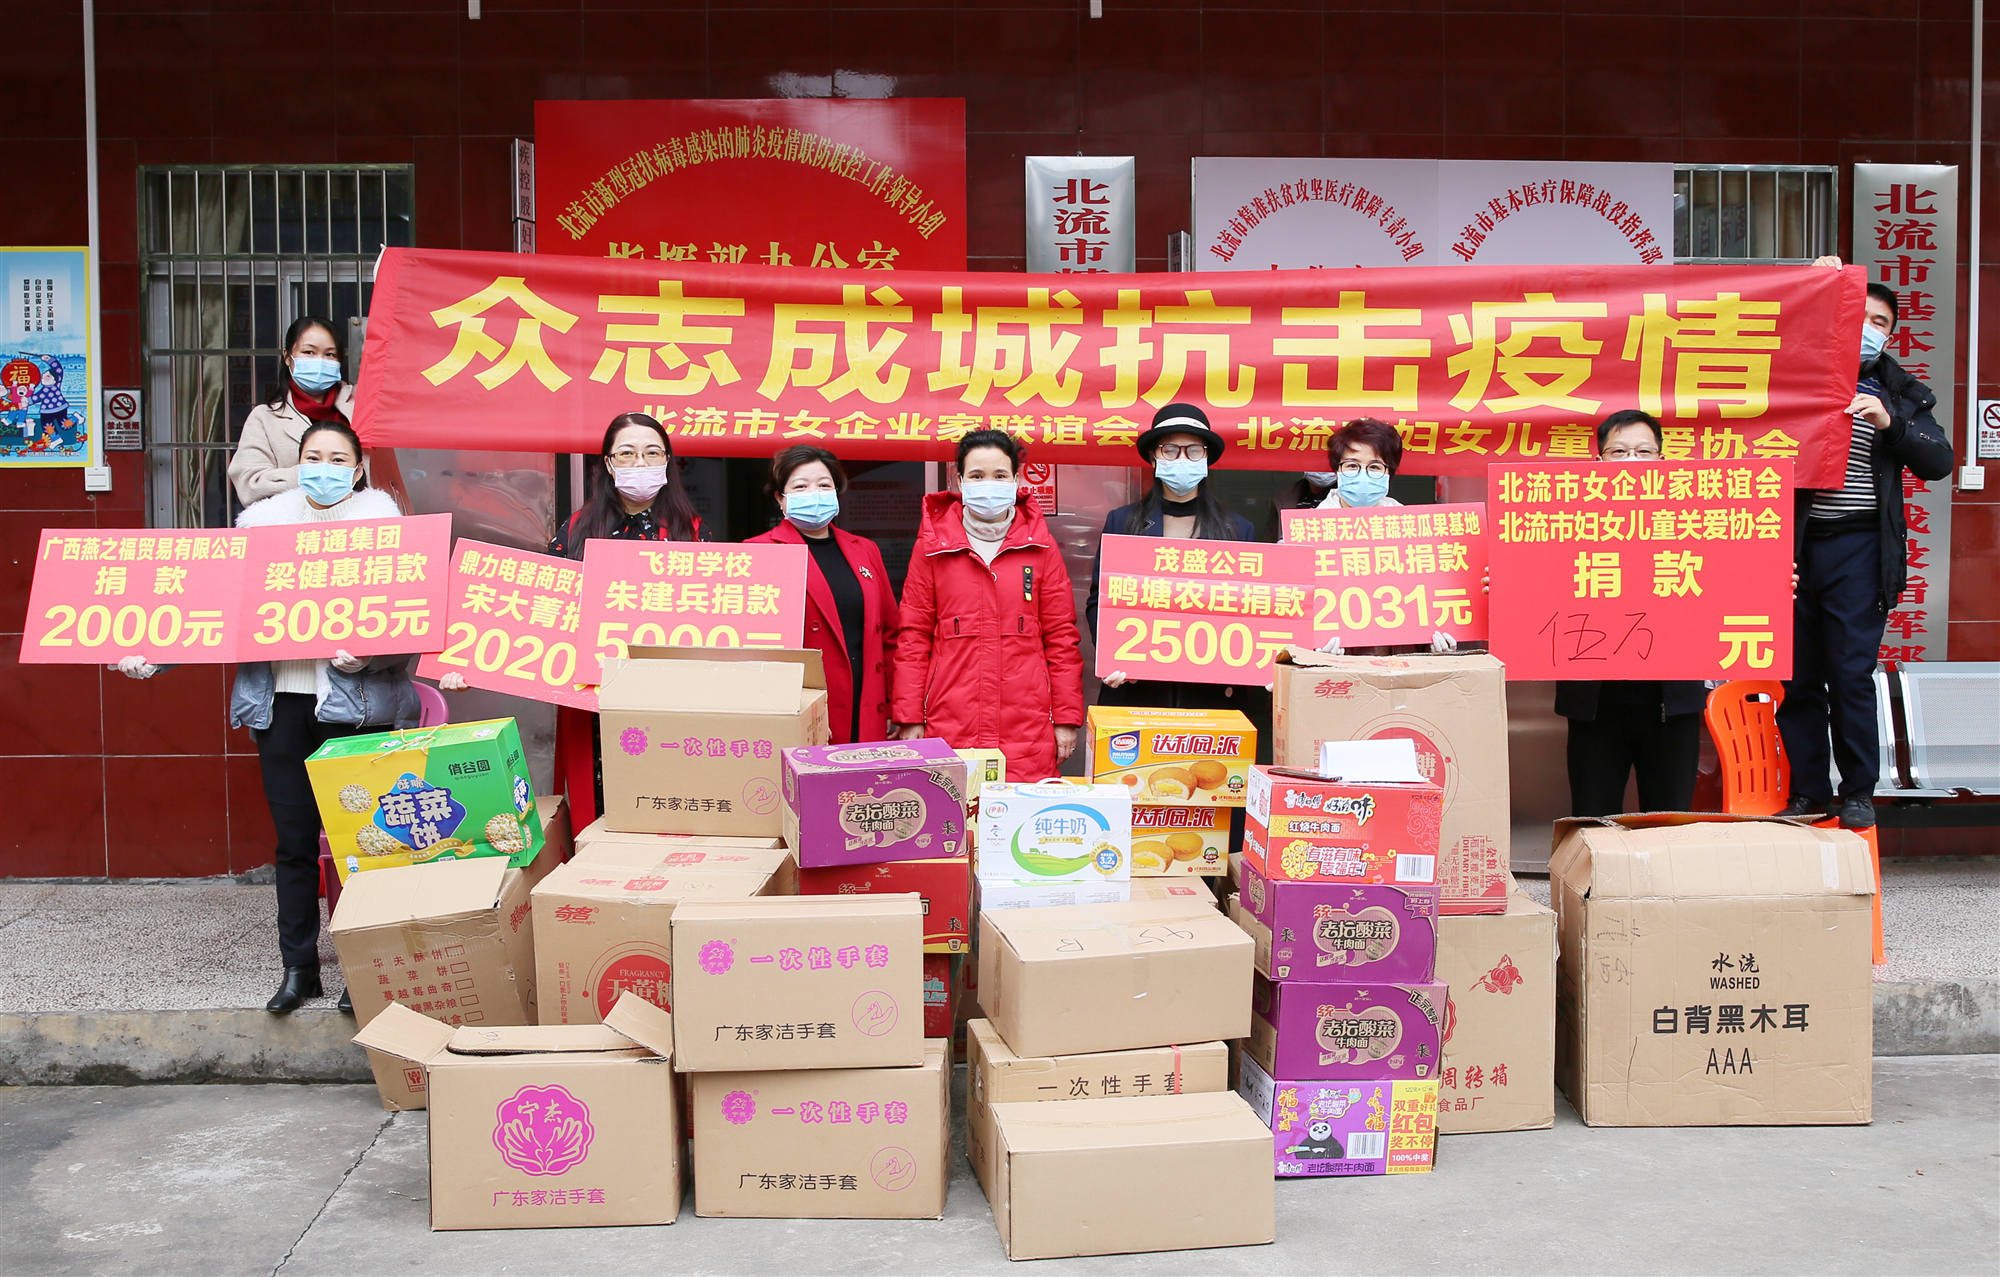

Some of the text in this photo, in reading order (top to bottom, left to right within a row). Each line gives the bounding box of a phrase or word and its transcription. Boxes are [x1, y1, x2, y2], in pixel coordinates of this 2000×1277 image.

[556, 125, 947, 240] 北流市新型冠状病毒感染的肺炎疫情联防联控工作领导小组
[1052, 178, 1111, 273] 北流市
[1209, 178, 1424, 262] 北流市精准扶贫攻坚医疗保障专责小组
[1451, 178, 1663, 264] 北流市基本医疗保障战役指挥部
[521, 223, 531, 254] 妇
[420, 276, 1781, 418] 众志成城抗击疫情
[9, 365, 31, 384] 福
[1237, 416, 1801, 464] 北流妇女儿童爱协会
[1498, 466, 1782, 504] 北流市女企业家联谊会
[1289, 511, 1480, 543] 绿沣源无公害蔬菜瓜果基地
[1498, 507, 1782, 543] 北流市妇女儿童关爱协会
[43, 536, 248, 561] 广西燕之福贸易有限公司
[295, 525, 402, 555] 精通集团
[264, 552, 428, 591] 梁健惠捐款
[639, 550, 753, 578] 飞翔学校
[1153, 547, 1263, 577] 茂盛公司
[1314, 542, 1470, 577] 王雨凤捐款
[94, 565, 188, 596] 捐款
[1573, 550, 1704, 598] 捐款
[605, 580, 781, 615] 朱建兵捐款
[1107, 576, 1305, 617] 鸭塘农庄捐款
[1313, 584, 1473, 632] 2031元
[39, 604, 225, 647] 2000元
[253, 595, 431, 645] 3085元
[1114, 617, 1297, 669] 2500元
[1538, 611, 1653, 667] 伍万
[1718, 615, 1774, 670] 元
[437, 622, 600, 695] 2020
[660, 737, 773, 759] 一次性手套
[380, 788, 453, 827] 蔬菜
[635, 796, 732, 813] 广东家洁手套
[846, 800, 920, 822] 老坛酸菜
[409, 822, 443, 849] 饼
[860, 819, 895, 832] 牛肉面
[1034, 817, 1087, 836] 纯牛奶
[1289, 822, 1341, 833] 红烧牛肉面
[1306, 847, 1363, 863] 有滋有味
[1320, 920, 1392, 939] 老坛酸菜
[750, 944, 889, 971] 一次性手套
[1334, 938, 1366, 950] 牛肉面
[1711, 953, 1760, 973] 水洗
[1710, 977, 1760, 989] WASHED
[714, 1022, 836, 1042] 广东家洁手套
[1322, 1019, 1395, 1038] 老坛酸菜
[1652, 1004, 1809, 1034] 白背黑木耳
[1335, 1037, 1369, 1048] 牛肉面
[1705, 1048, 1753, 1075] AAA
[1038, 1072, 1183, 1097] 一次性手套
[1440, 1063, 1508, 1090] 周转箱
[517, 1099, 562, 1125] 宁杰
[771, 1101, 908, 1124] 一次性手套
[1438, 1096, 1485, 1112] 食品厂
[1391, 1113, 1434, 1133] 红包
[1390, 1135, 1433, 1148] 奖不停
[739, 1173, 858, 1191] 广东家洁手套
[492, 1188, 605, 1207] 广东家洁手套
